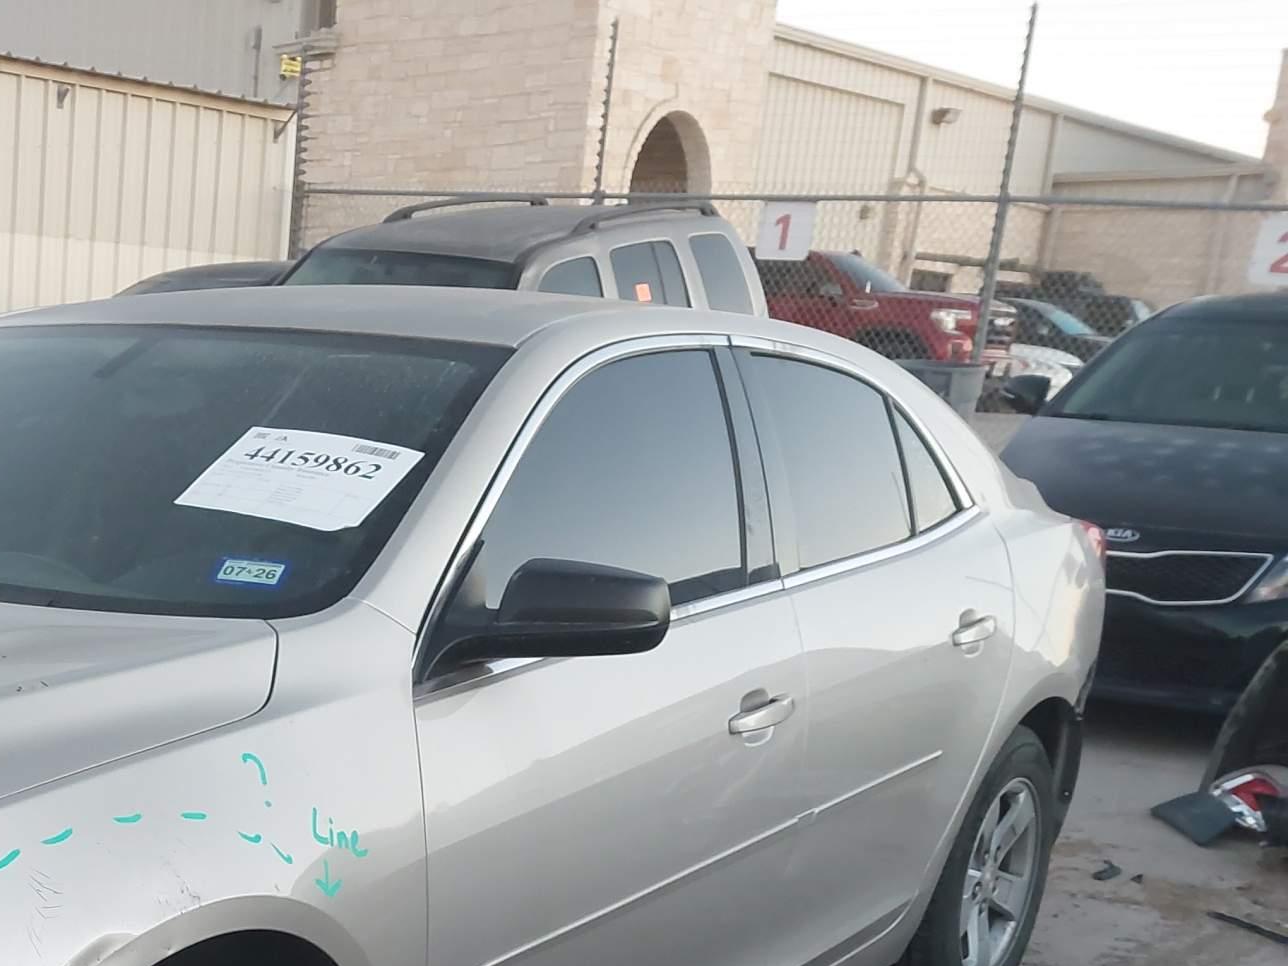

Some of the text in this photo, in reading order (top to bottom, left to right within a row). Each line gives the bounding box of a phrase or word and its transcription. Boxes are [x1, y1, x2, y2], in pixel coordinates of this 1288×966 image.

[775, 213, 791, 250] 1
[244, 446, 382, 480] 44159862
[222, 565, 277, 580] 07 26
[312, 806, 368, 857] Line
